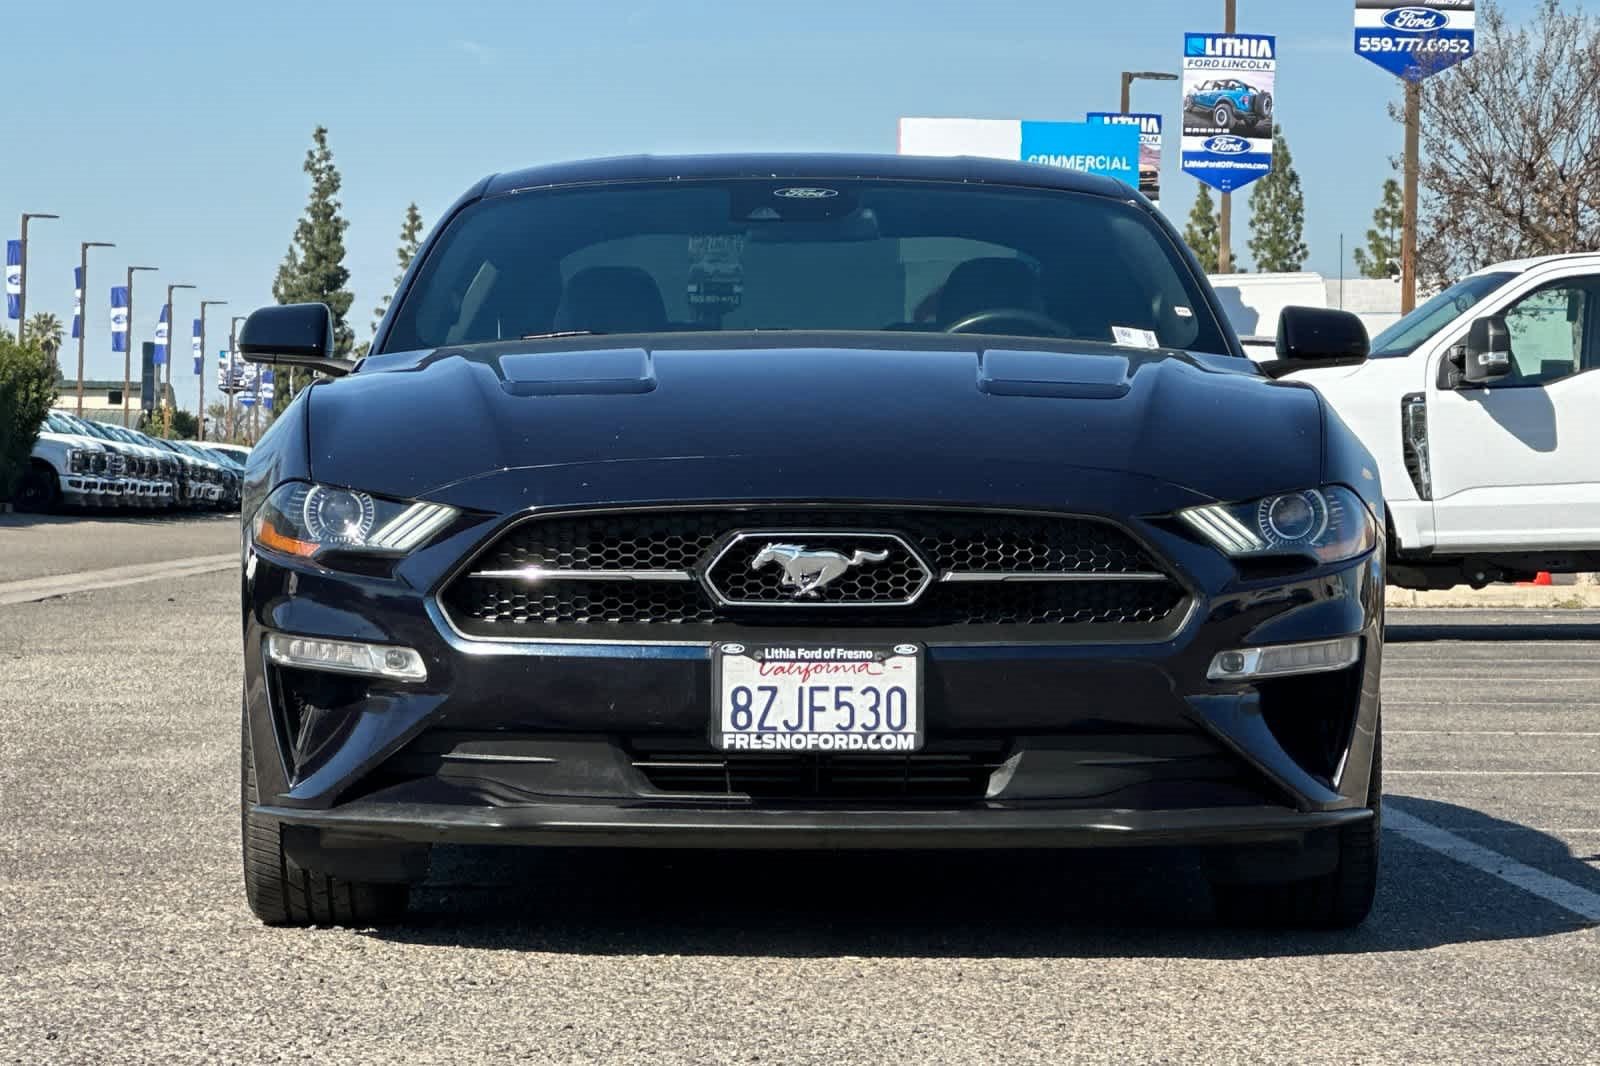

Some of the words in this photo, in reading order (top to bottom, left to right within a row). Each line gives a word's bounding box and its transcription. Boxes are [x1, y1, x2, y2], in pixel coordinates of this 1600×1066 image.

[1394, 9, 1437, 28] Ford
[1205, 37, 1272, 58] LITHIA
[1187, 59, 1220, 68] FORD
[1221, 60, 1272, 70] LINCOLN
[784, 187, 827, 198] Ford
[764, 647, 797, 659] Lithia
[797, 647, 822, 659] Ford
[823, 647, 836, 659] of
[836, 648, 873, 660] Fresno
[730, 685, 908, 732] 8ZJF530
[722, 733, 915, 750] FRESNOFORD.COM
